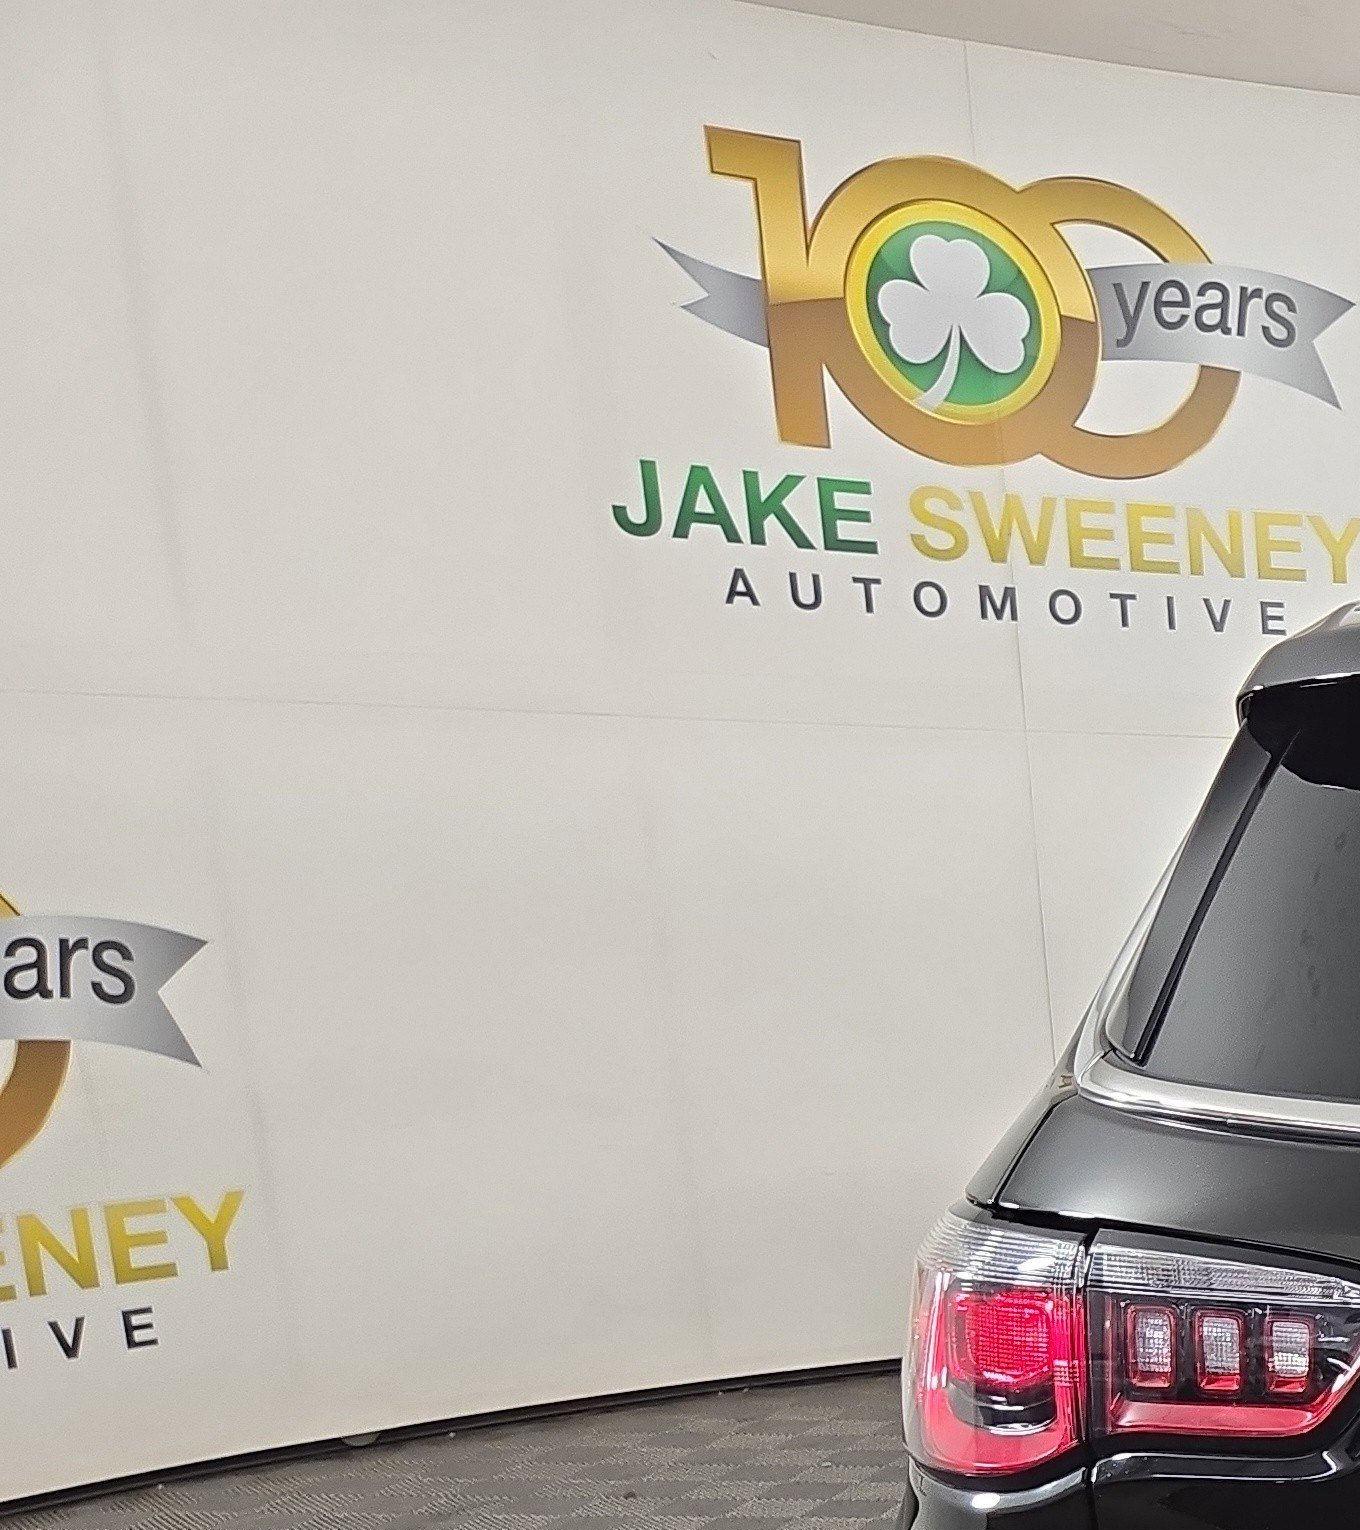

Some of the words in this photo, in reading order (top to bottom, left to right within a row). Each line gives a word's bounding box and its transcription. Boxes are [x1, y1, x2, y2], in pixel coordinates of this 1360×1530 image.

[1112, 277, 1299, 351] years
[612, 459, 879, 555] JAKE
[725, 567, 1288, 636] AUTOMOTIVE
[0, 1190, 244, 1301] NEY
